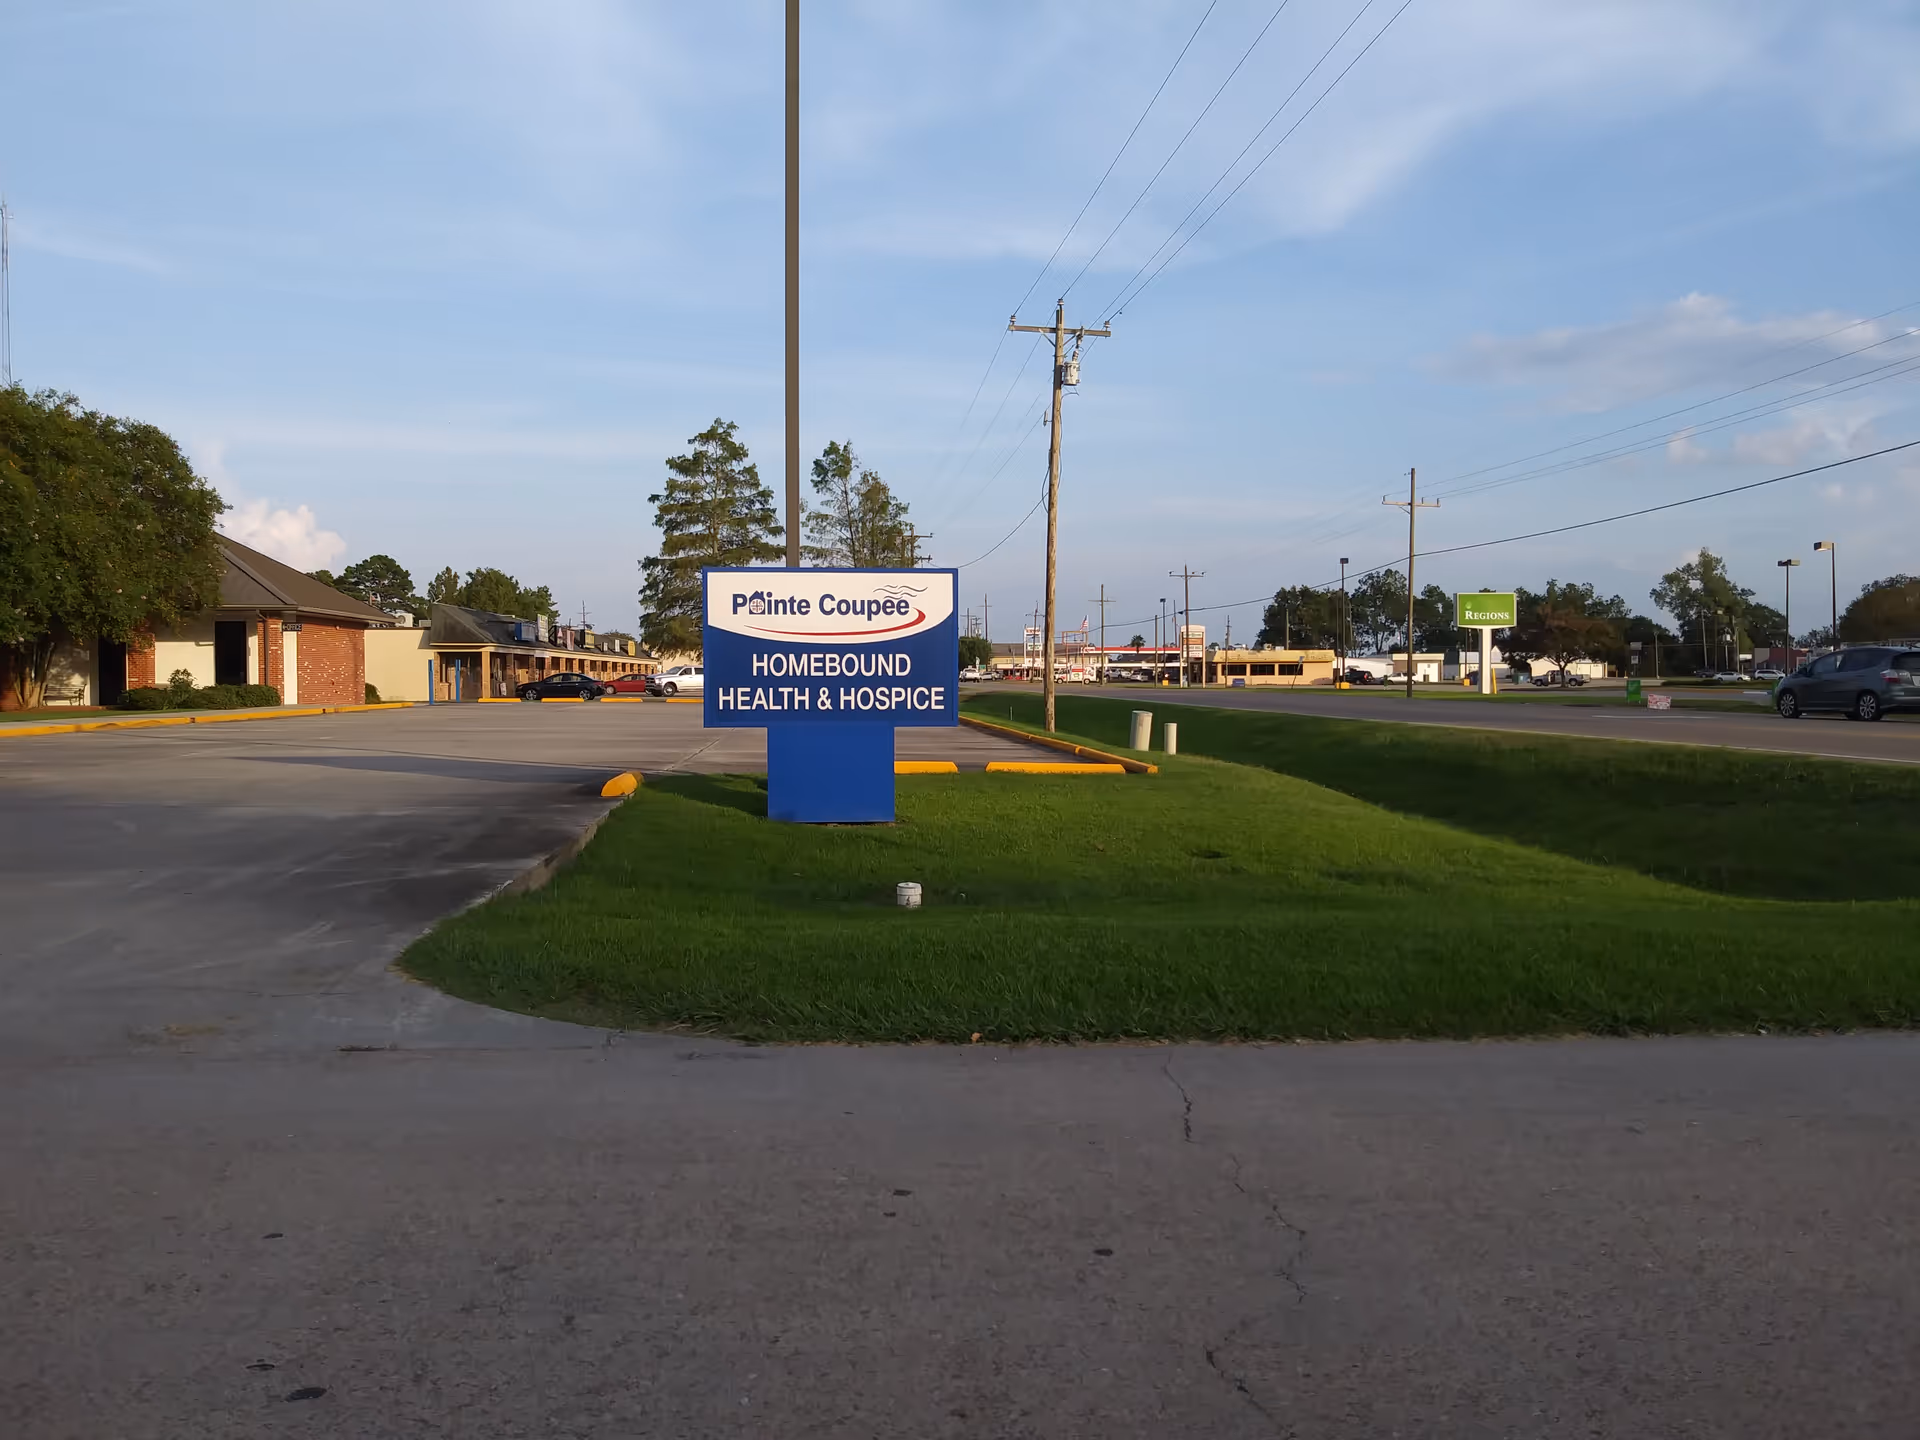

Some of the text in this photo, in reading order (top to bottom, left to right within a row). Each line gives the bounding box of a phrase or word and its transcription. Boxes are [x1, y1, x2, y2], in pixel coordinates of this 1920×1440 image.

[732, 590, 811, 615] Pointe
[818, 593, 910, 622] Coupee
[1465, 611, 1510, 620] REGIONS
[752, 653, 912, 677] HOMEBOUND
[718, 686, 945, 711] HEALTH & HOSPICE
